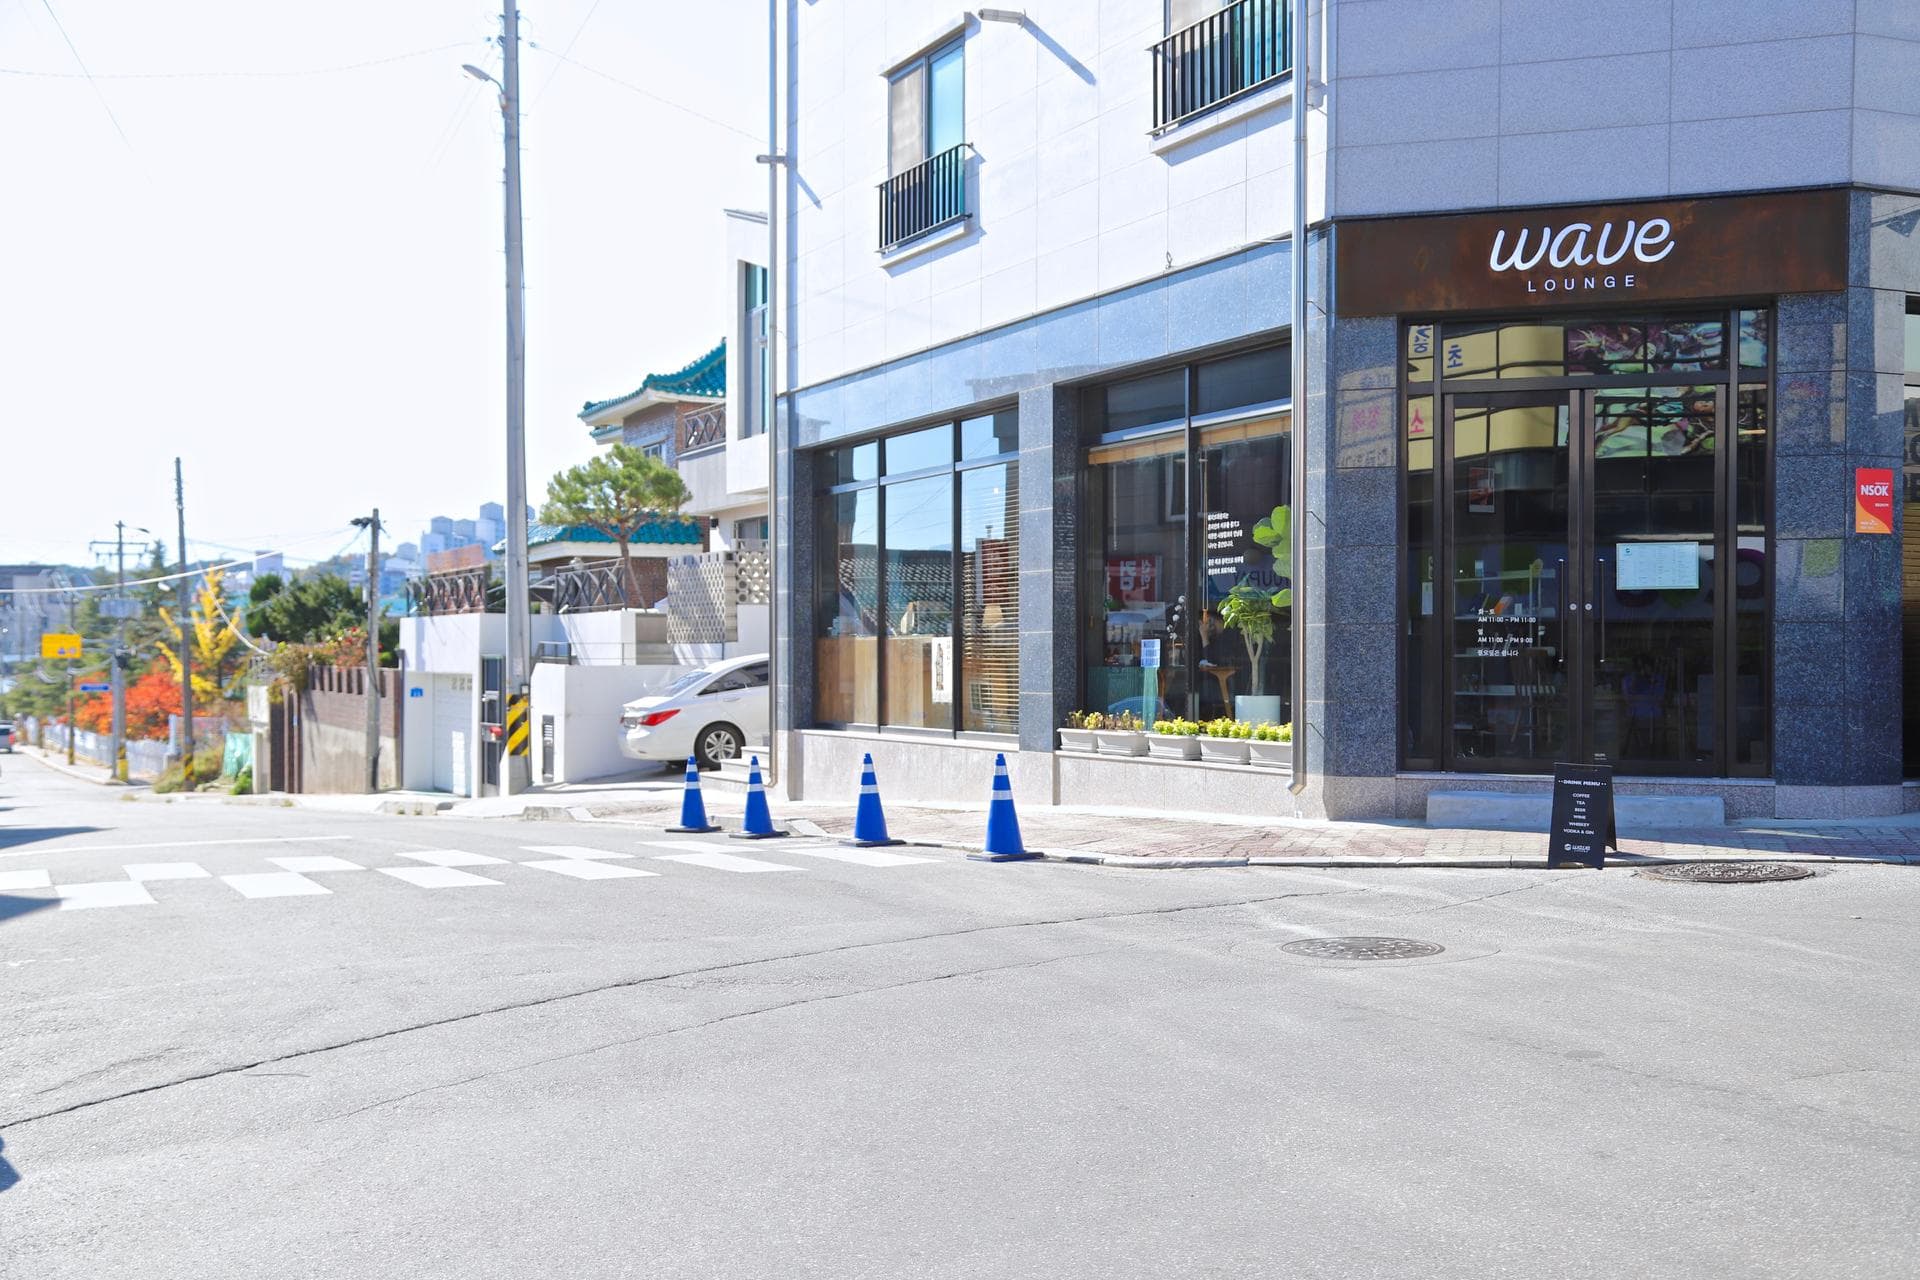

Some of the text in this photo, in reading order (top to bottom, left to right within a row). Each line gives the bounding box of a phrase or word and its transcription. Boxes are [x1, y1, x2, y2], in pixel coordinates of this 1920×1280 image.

[1489, 218, 1675, 272] wave
[1527, 275, 1635, 292] LOUNGE
[1860, 484, 1889, 497] NSOK
